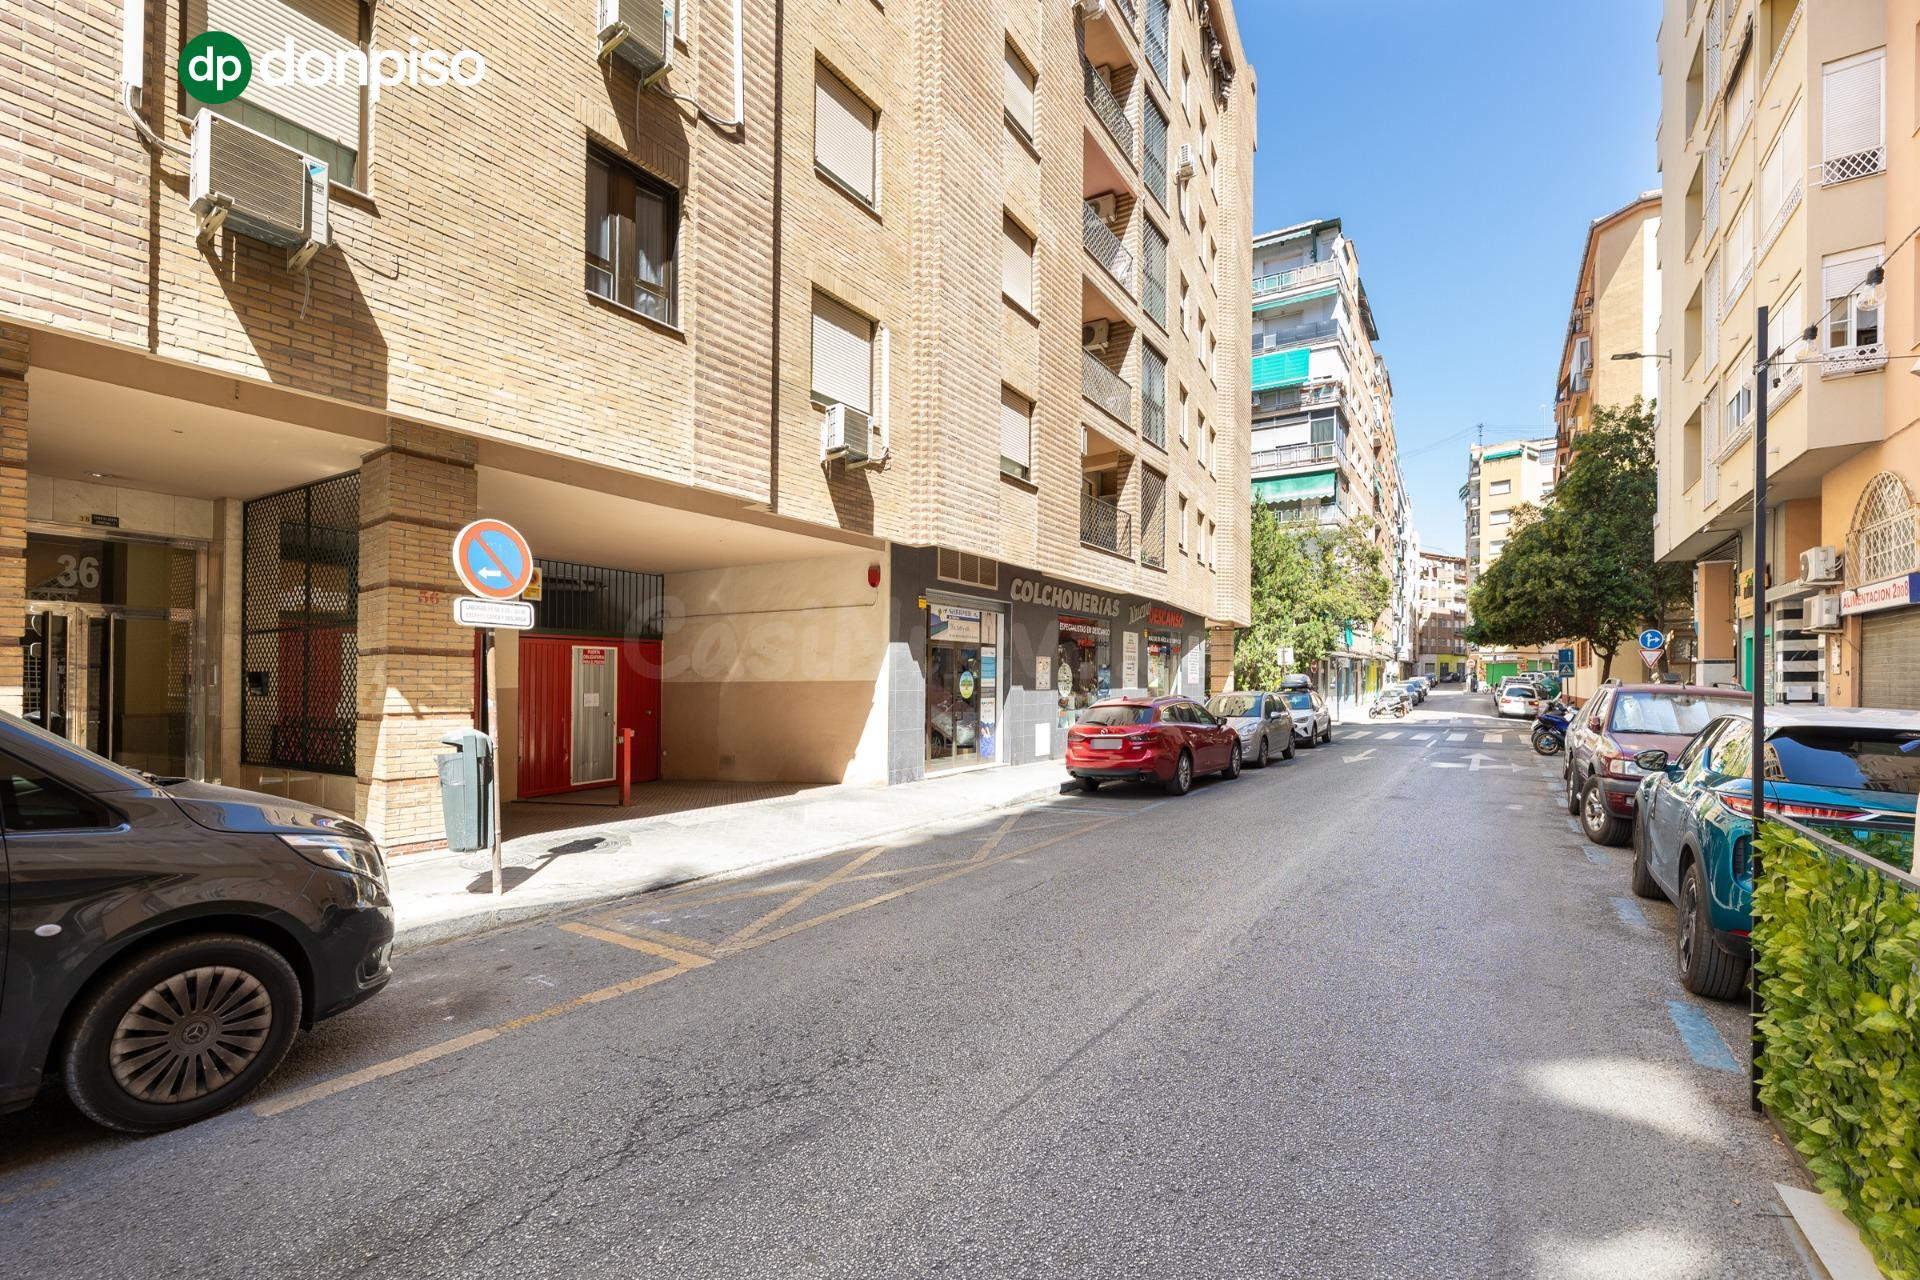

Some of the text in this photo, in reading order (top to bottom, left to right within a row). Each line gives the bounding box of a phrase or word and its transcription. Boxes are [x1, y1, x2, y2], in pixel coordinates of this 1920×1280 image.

[57, 555, 99, 589] 36
[1011, 578, 1120, 617] COLCHONERÍAS
[1843, 580, 1909, 609] ALIMENTACION 2008
[1147, 608, 1185, 629] DESCANSO
